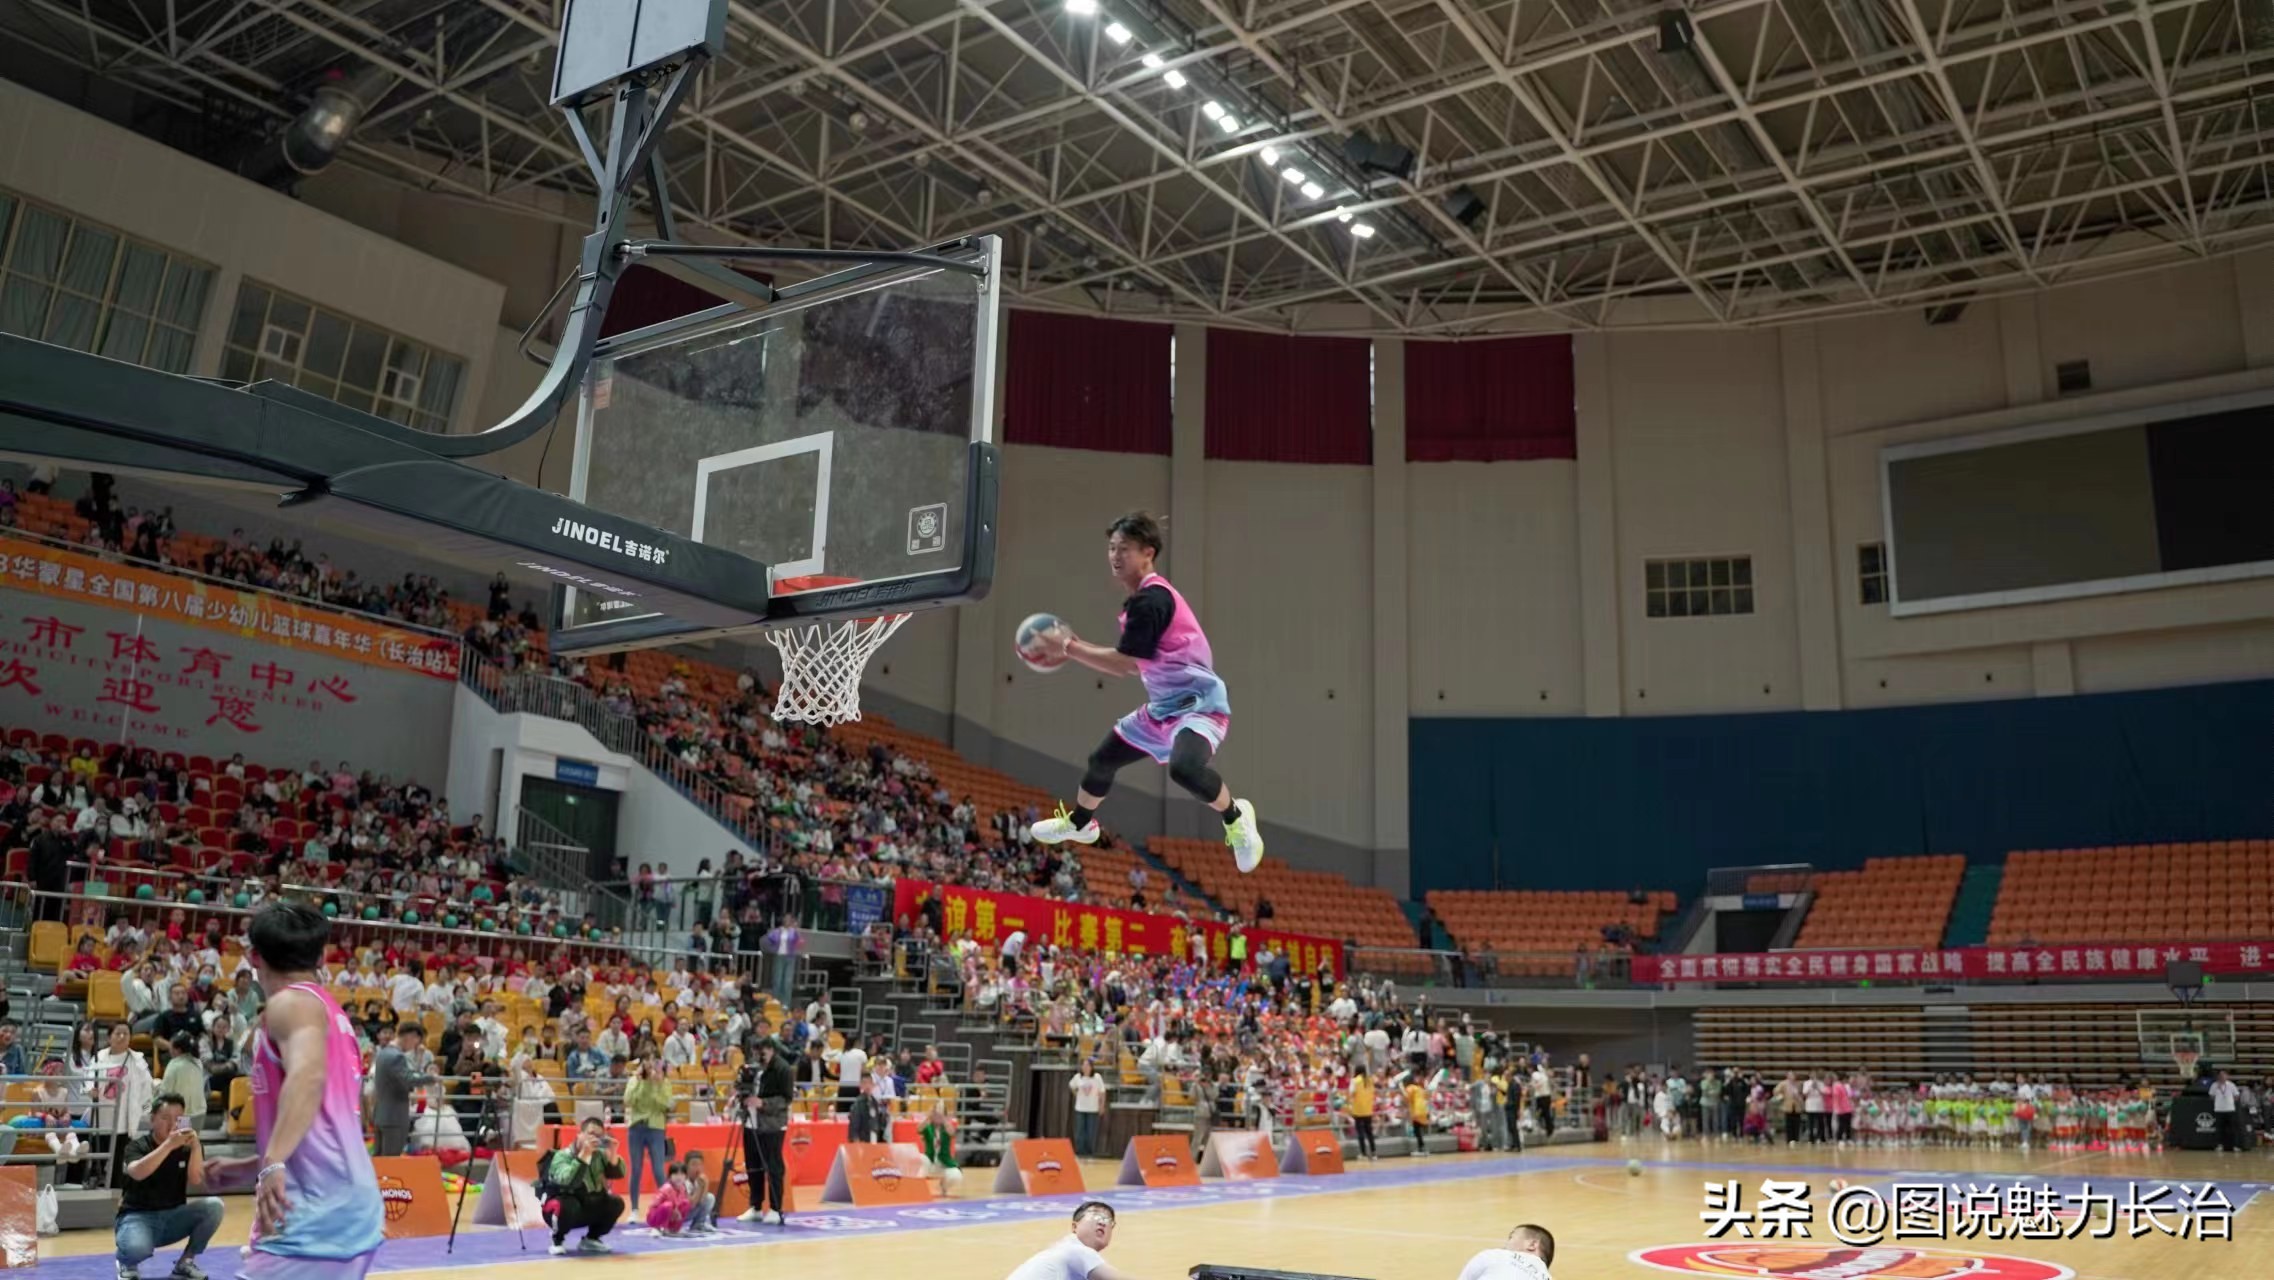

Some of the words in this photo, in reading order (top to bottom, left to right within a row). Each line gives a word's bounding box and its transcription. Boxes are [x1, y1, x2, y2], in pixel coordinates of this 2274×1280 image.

[552, 518, 622, 553] JINOEL
[624, 540, 666, 565] 吉诺尔
[915, 889, 1025, 941] 谊第一
